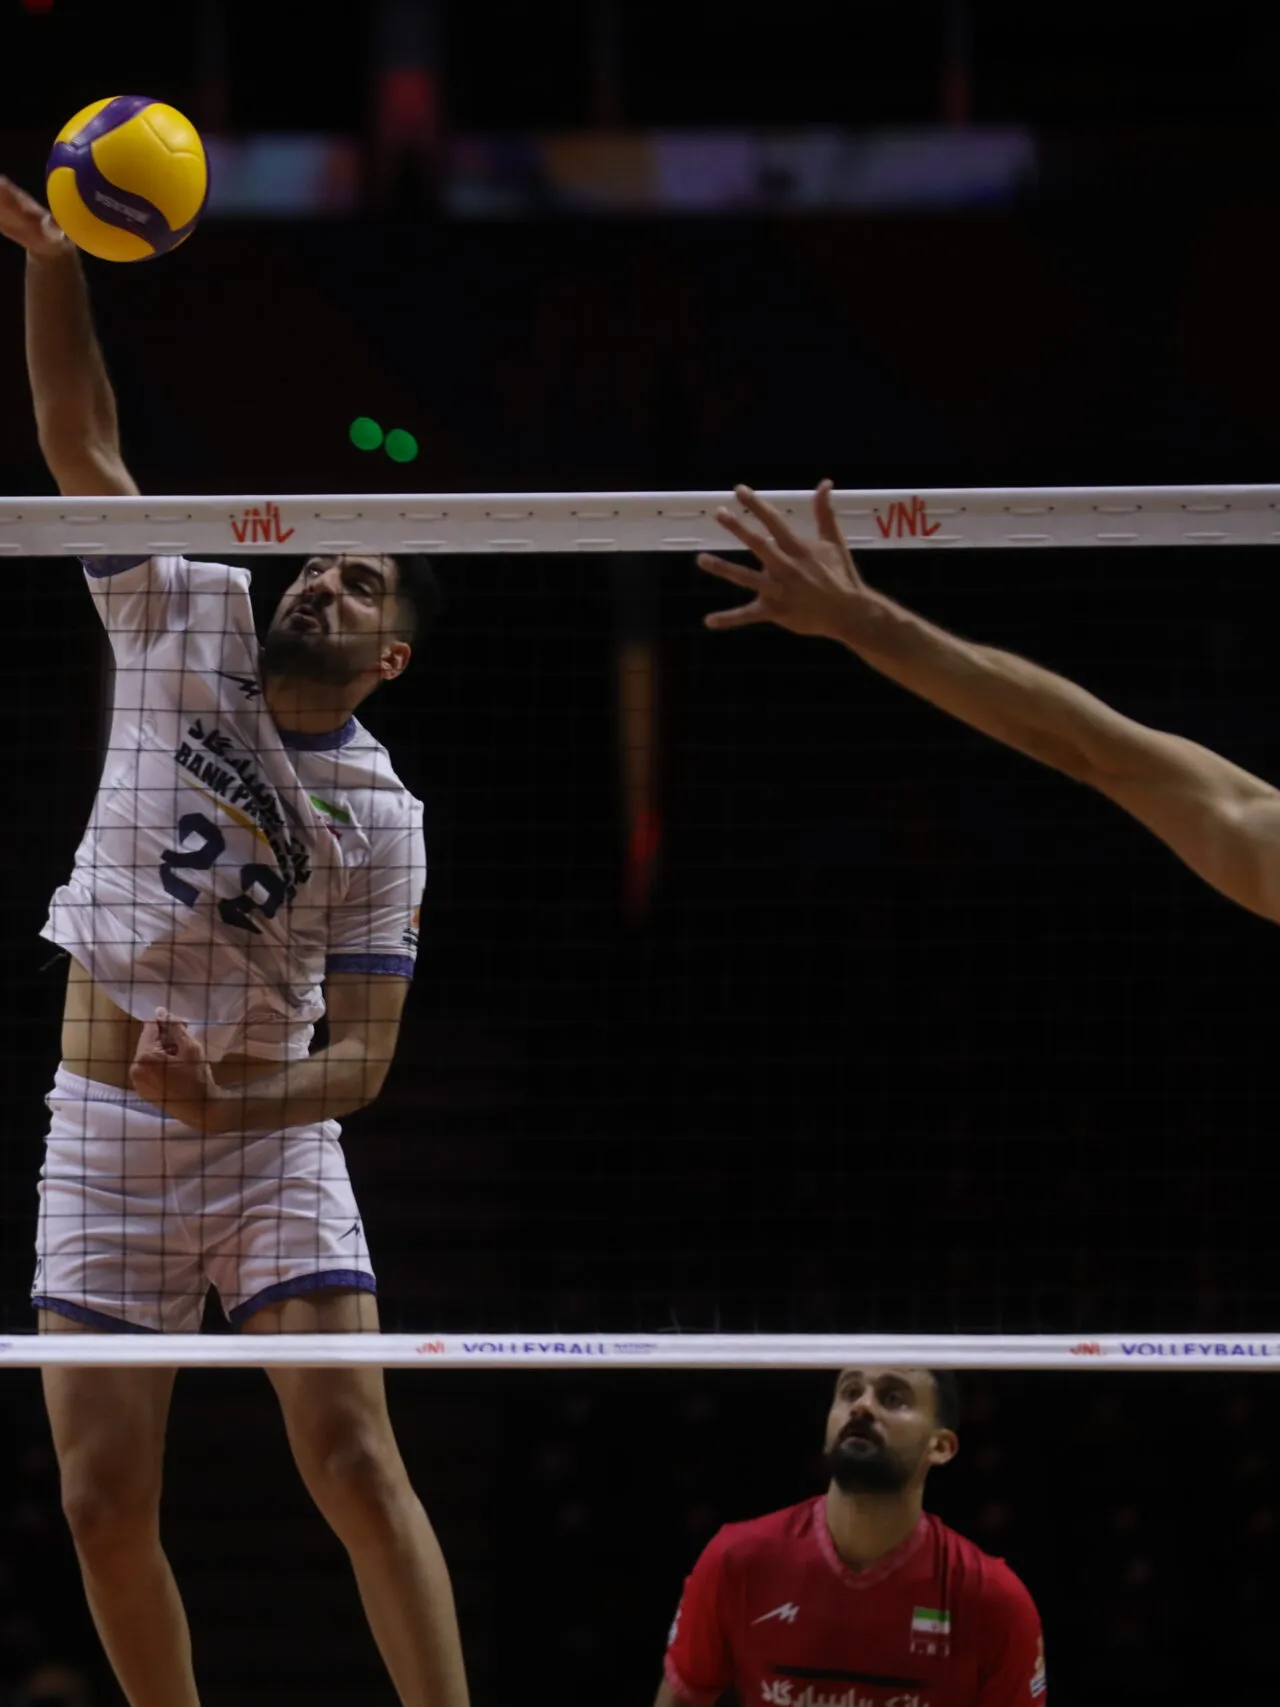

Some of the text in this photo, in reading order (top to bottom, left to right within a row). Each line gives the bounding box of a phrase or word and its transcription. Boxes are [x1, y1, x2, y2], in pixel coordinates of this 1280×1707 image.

[230, 501, 296, 543] VNL
[875, 495, 942, 539] VNL
[174, 741, 234, 798] BANK
[463, 1342, 604, 1354] VOLLEYBALL
[1121, 1342, 1269, 1356] VOLLEYBALL
